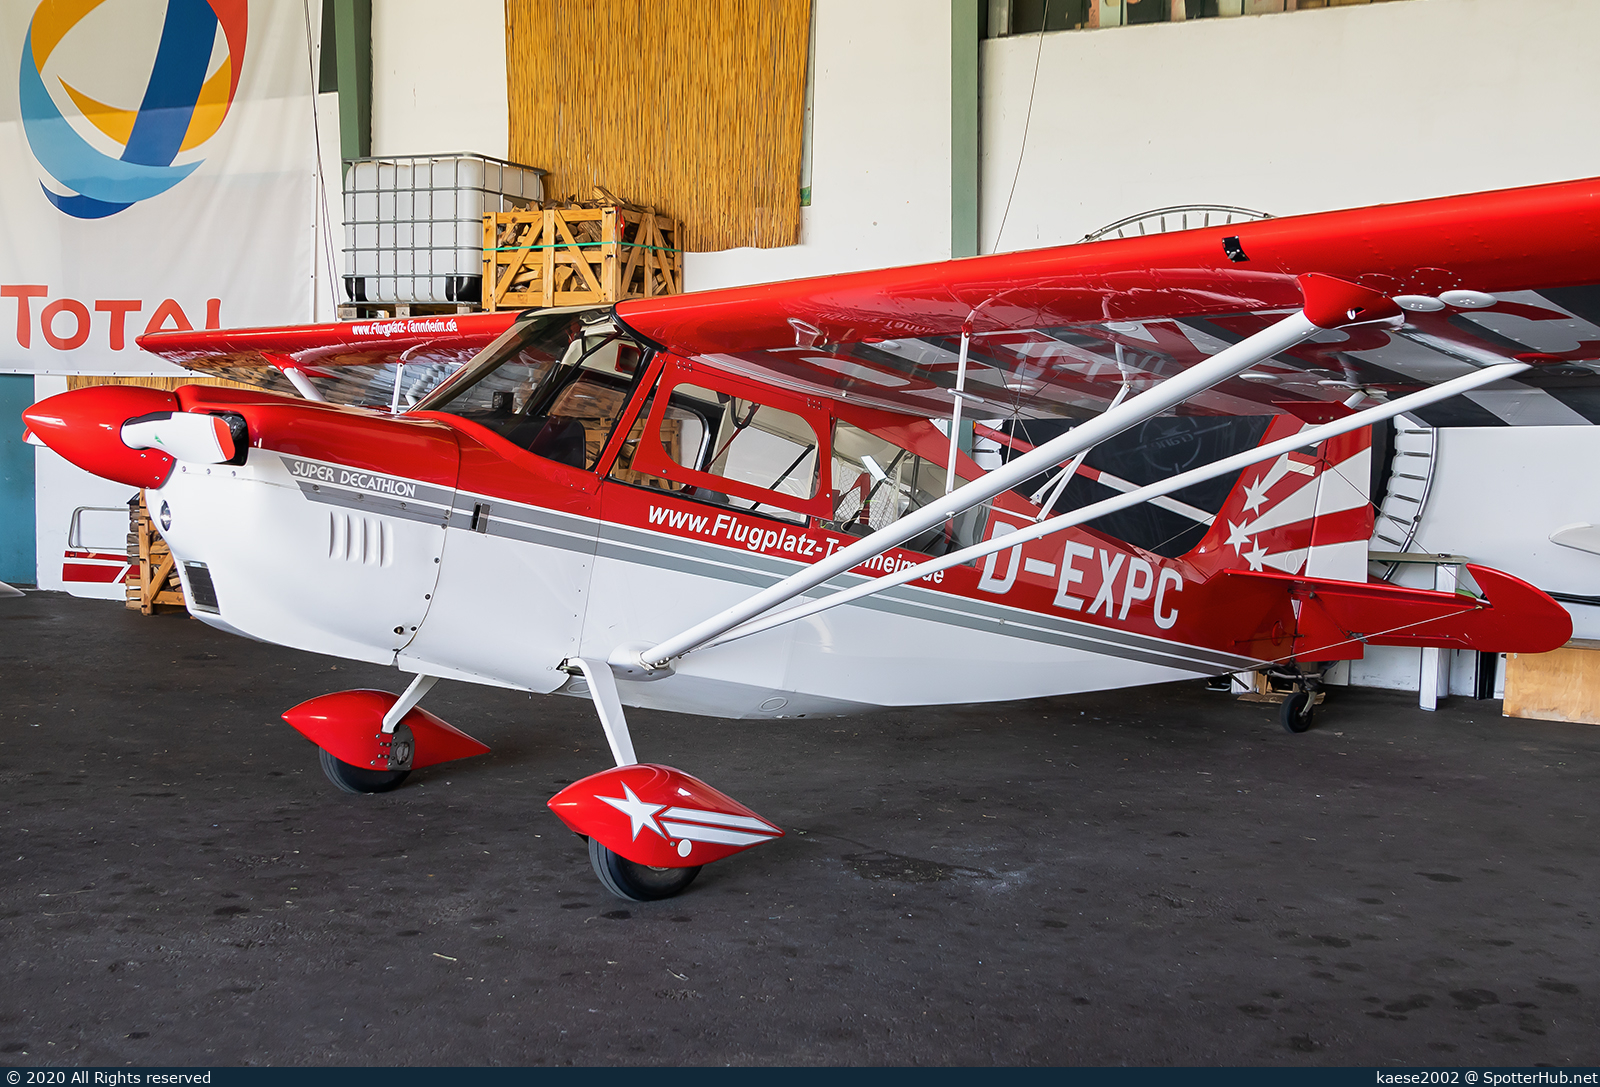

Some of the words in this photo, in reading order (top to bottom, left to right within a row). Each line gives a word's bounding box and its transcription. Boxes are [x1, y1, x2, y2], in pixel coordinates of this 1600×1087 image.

[351, 319, 458, 337] www.Flugplatz-Tannheim.de
[292, 461, 335, 482] SUPER
[339, 471, 416, 498] DECATHLON
[977, 520, 1183, 630] D-EXPC
